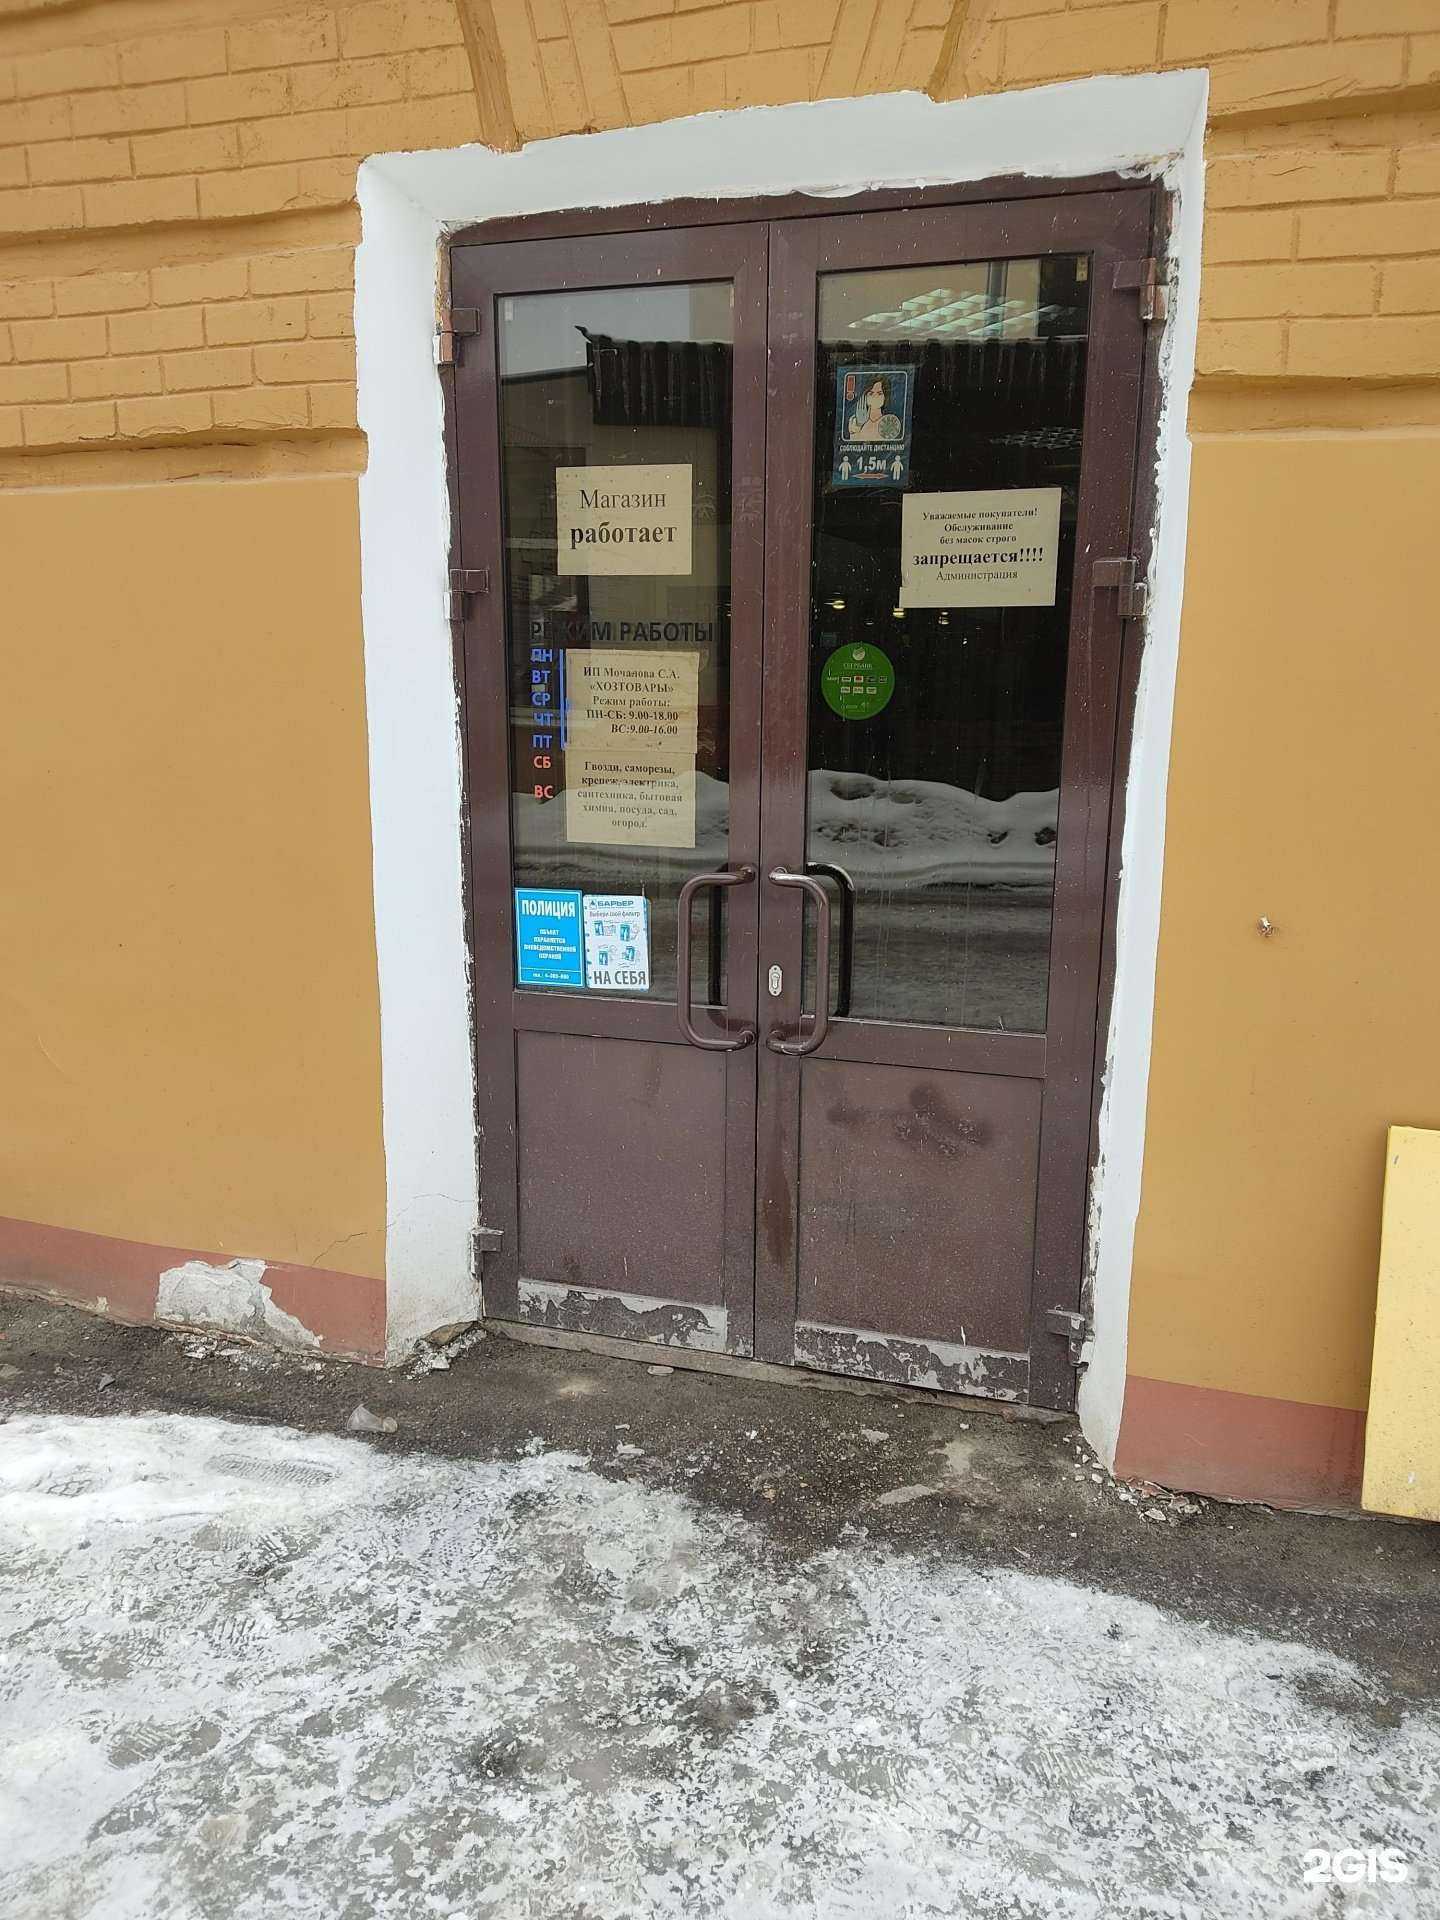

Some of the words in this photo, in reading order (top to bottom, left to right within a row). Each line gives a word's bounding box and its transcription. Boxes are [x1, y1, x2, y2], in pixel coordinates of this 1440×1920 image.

[839, 443, 873, 453] СОБЛЮДАЙТЕ
[874, 443, 905, 453] ДИСТАНЦИЮ
[579, 488, 667, 509] Магазин
[922, 511, 976, 521] Уважаемые
[978, 507, 1038, 521] покупатели!
[944, 522, 1014, 534] Обслуживание
[570, 521, 678, 550] работает
[939, 535, 954, 545] без
[955, 536, 984, 545] масок
[986, 535, 1017, 546] строго
[911, 547, 1044, 569] запрещается!!!!
[936, 570, 1018, 583] Администрация
[620, 621, 713, 642] РАБОТЫ
[531, 669, 552, 684] ВТ
[583, 666, 600, 678] ИП
[658, 668, 680, 680] С.А.
[590, 681, 674, 693] «ХОЗТОВАРЫ»
[531, 692, 551, 706] СР
[593, 695, 626, 706] Режим
[629, 697, 671, 709] работы:
[533, 712, 554, 726] ЧТ
[586, 709, 627, 720] ПН-СБ:
[628, 710, 679, 721] 9.00-18.00
[532, 735, 553, 749] ПТ
[533, 755, 552, 769] СБ
[584, 761, 622, 773] Гвозди,
[624, 764, 676, 776] саморезы,
[534, 785, 554, 799] ВС
[577, 790, 637, 801] сантехника,
[639, 791, 683, 802] бытовая
[583, 804, 617, 814] химия,
[619, 806, 656, 816] посуда,
[522, 899, 576, 919] ПОЛИЦИЯ
[597, 899, 635, 907] БАРЬЕР
[593, 970, 610, 985] НА
[613, 970, 647, 986] СЕБЯ
